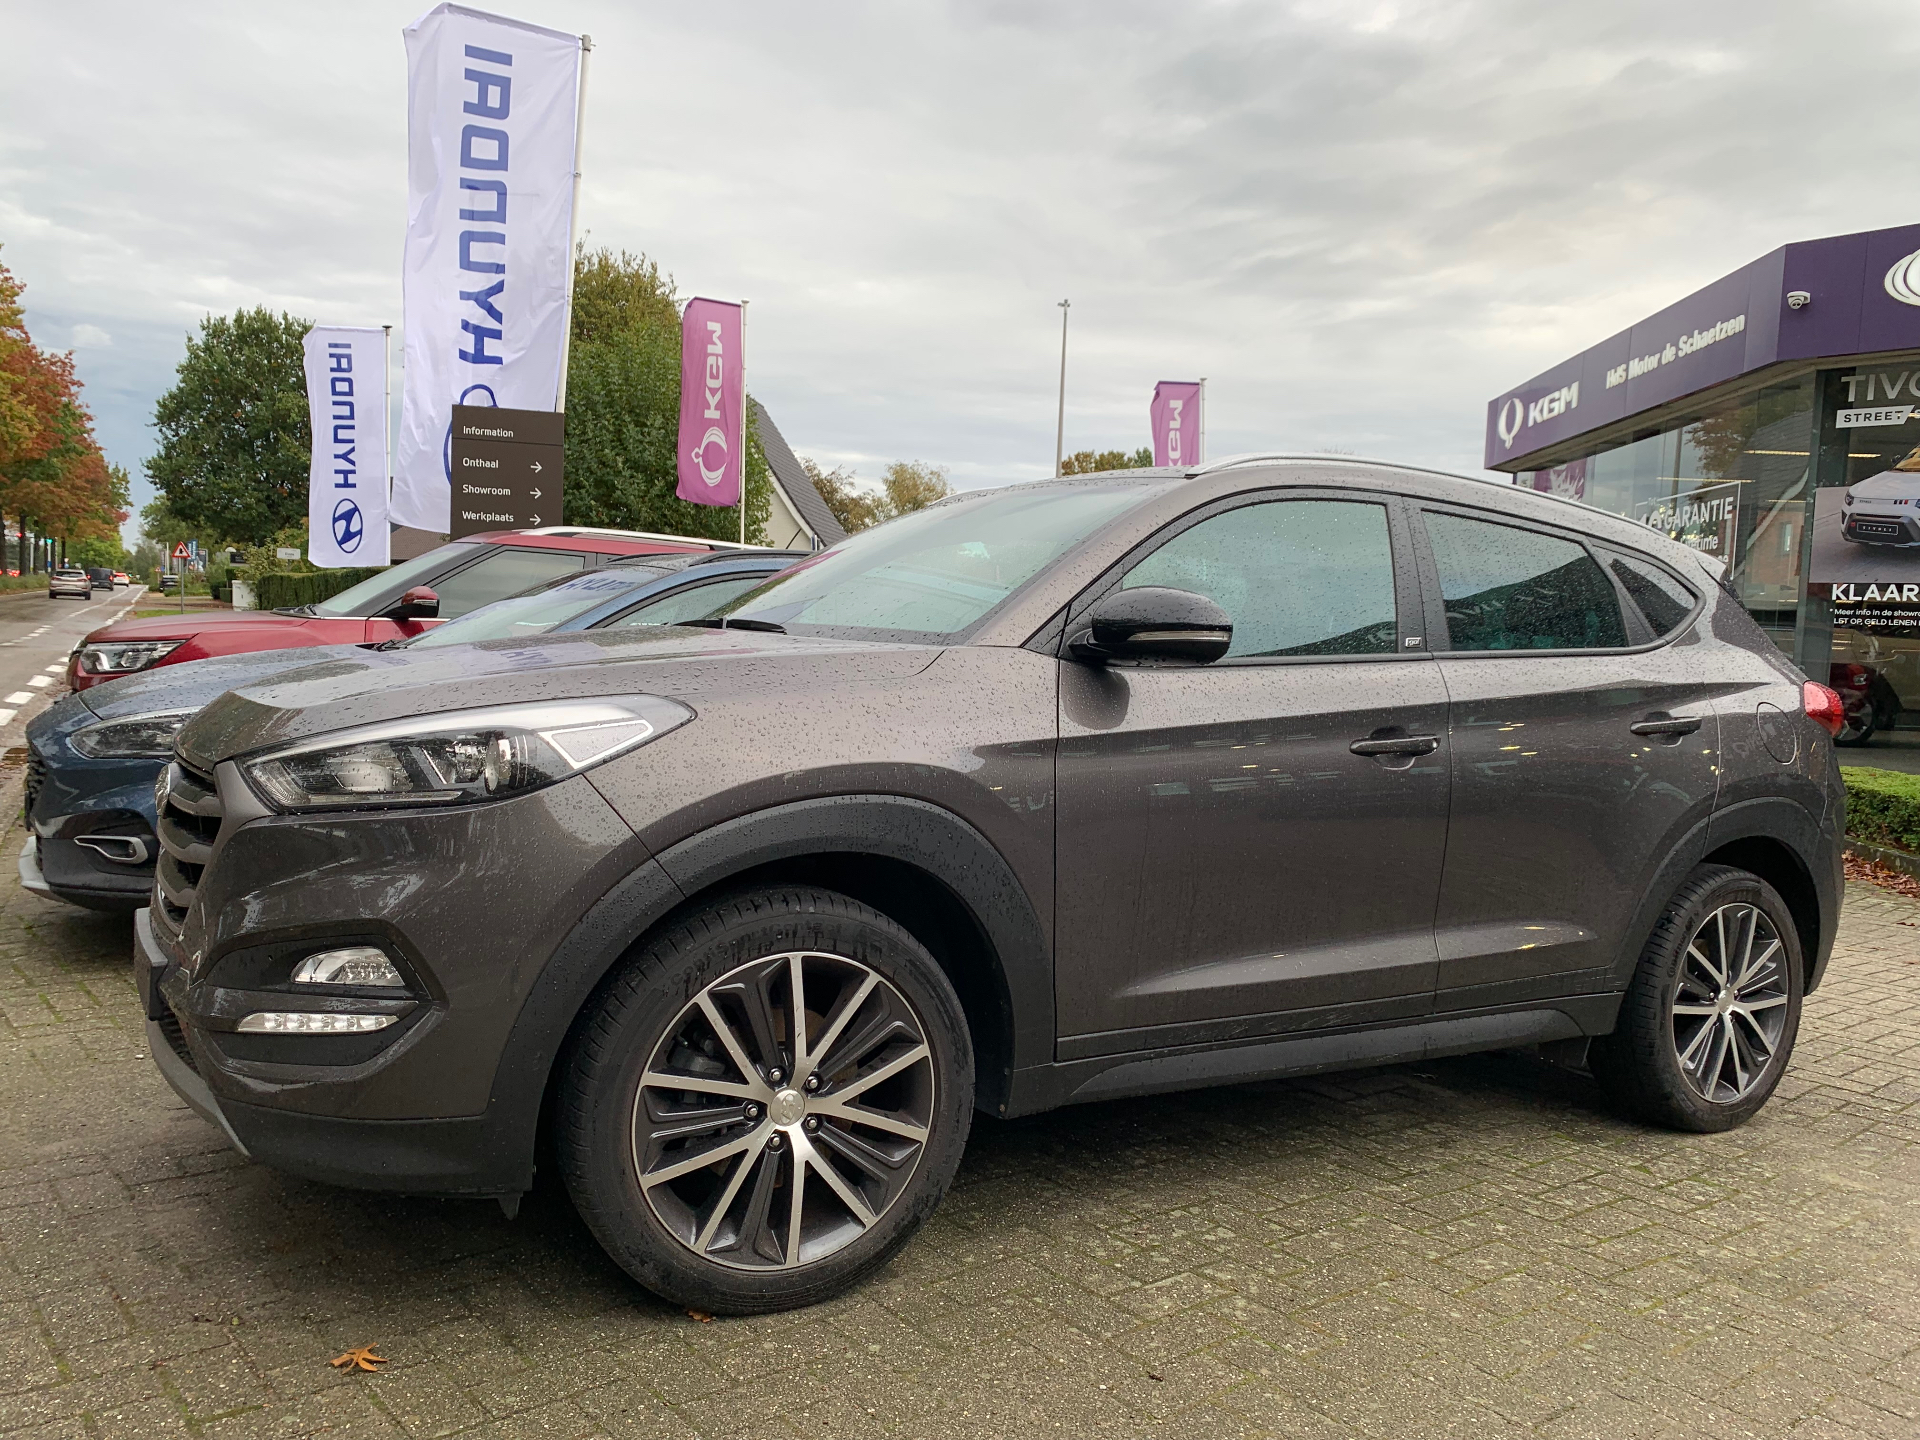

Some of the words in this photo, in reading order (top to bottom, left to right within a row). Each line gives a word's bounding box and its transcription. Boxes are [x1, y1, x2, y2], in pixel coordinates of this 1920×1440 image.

[1627, 353, 1660, 380] Motor
[1662, 342, 1676, 365] de
[1678, 314, 1745, 357] Schaetzen
[1528, 380, 1579, 428] KGM
[1843, 410, 1904, 423] STREET
[463, 425, 514, 438] Information
[462, 457, 499, 469] Onthaal
[462, 484, 511, 496] Showroom
[462, 510, 514, 523] Werkplaats
[1665, 496, 1734, 530] GARANTIE
[1831, 584, 1919, 602] KLAAR
[1856, 608, 1871, 616] info
[1872, 608, 1880, 616] in
[1881, 608, 1892, 616] de
[1833, 617, 1849, 625] LET
[1864, 618, 1887, 626] GELD
[1888, 618, 1917, 626] LENEN
